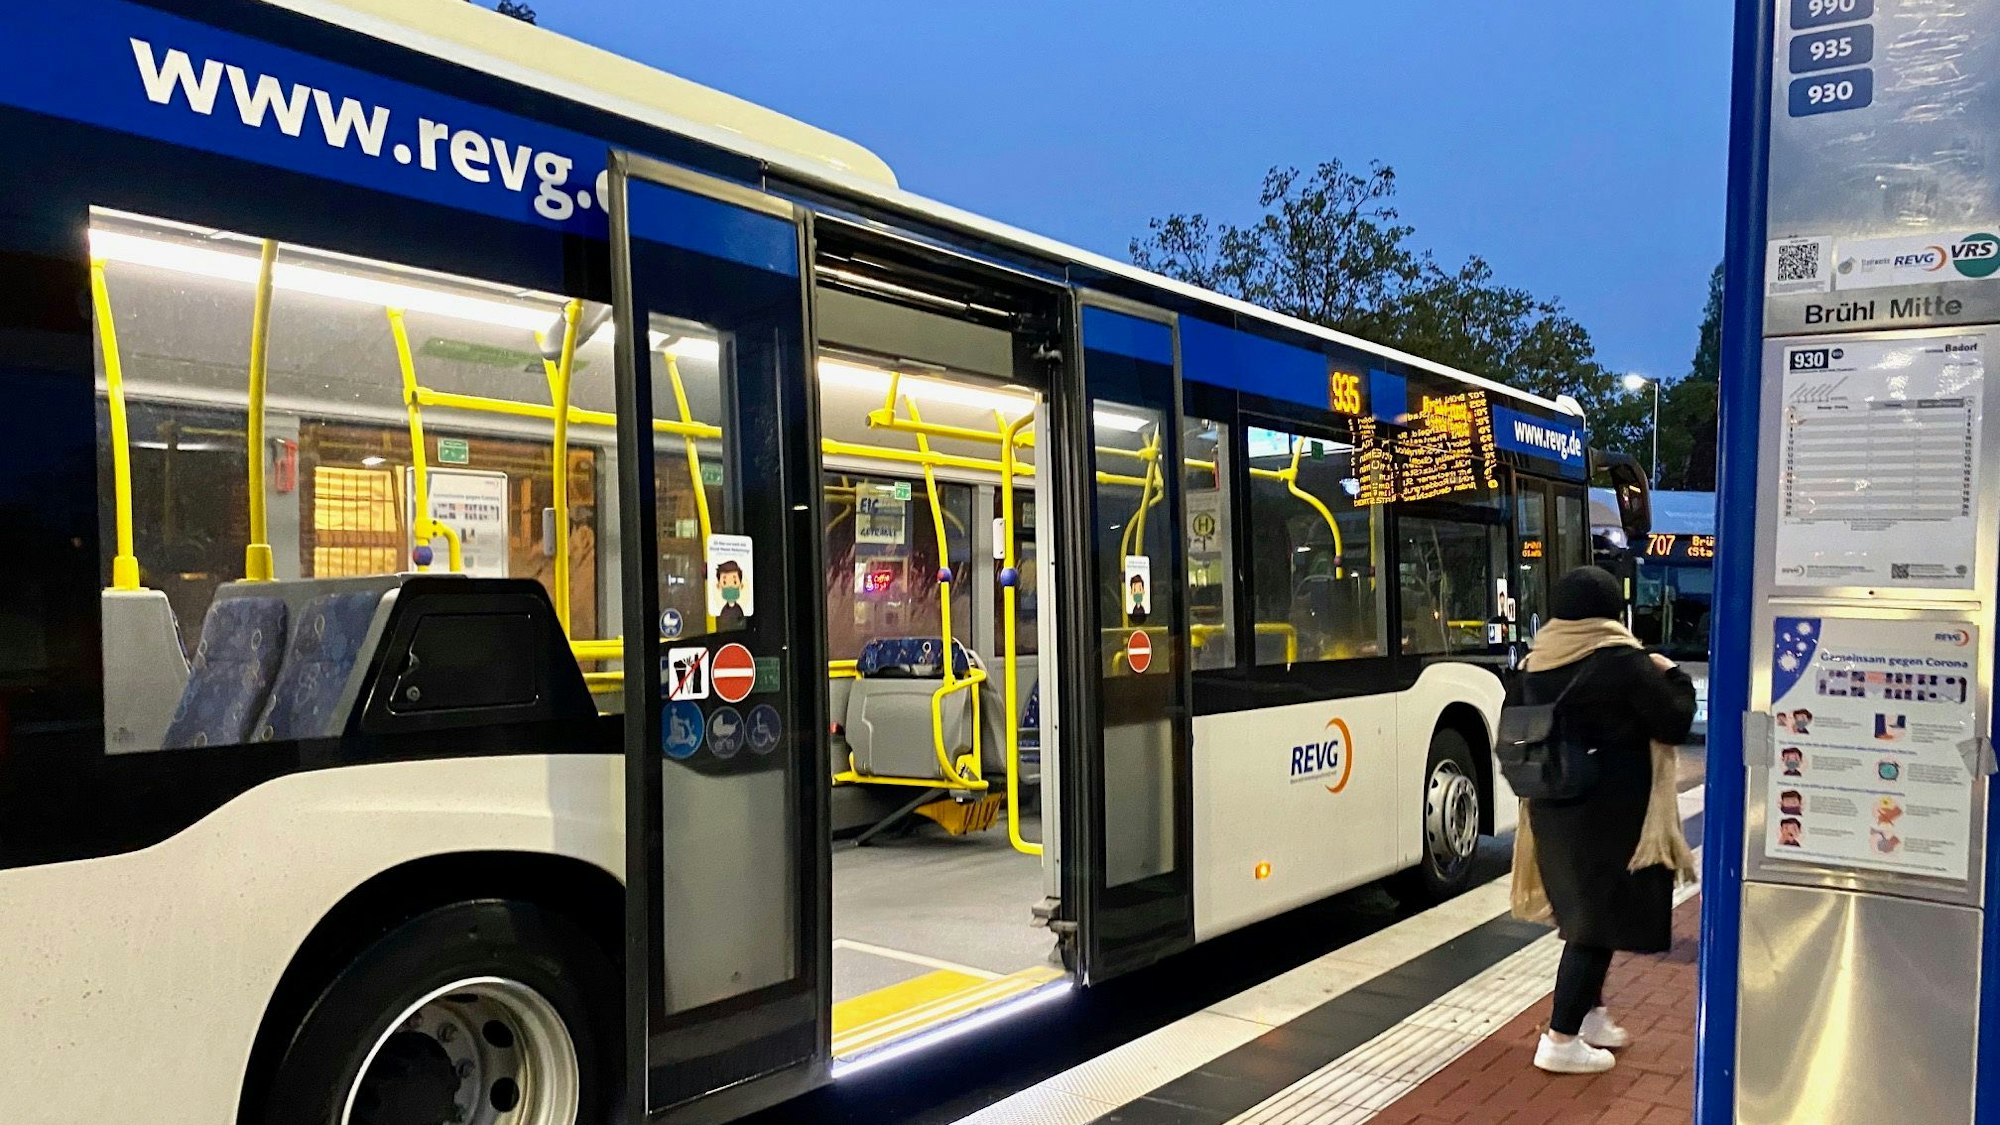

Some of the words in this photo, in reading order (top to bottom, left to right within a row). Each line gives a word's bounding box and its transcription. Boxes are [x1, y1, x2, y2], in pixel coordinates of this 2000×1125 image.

[1808, 0, 1855, 18] 990
[1810, 37, 1852, 61] 935
[1808, 80, 1853, 105] 930
[1894, 252, 1936, 266] REVG
[1951, 241, 1993, 258] VRS
[1805, 300, 1874, 324] Brühl
[1890, 296, 1962, 319] Mitte
[1945, 343, 1977, 353] Badorf
[1794, 352, 1824, 368] 930
[1332, 371, 1360, 414] 935
[1514, 420, 1581, 460] www.revg.de
[1647, 534, 1676, 555] 707
[1889, 658, 1922, 668] gegen
[1926, 657, 1968, 668] Corona
[1291, 740, 1338, 776] REVG
